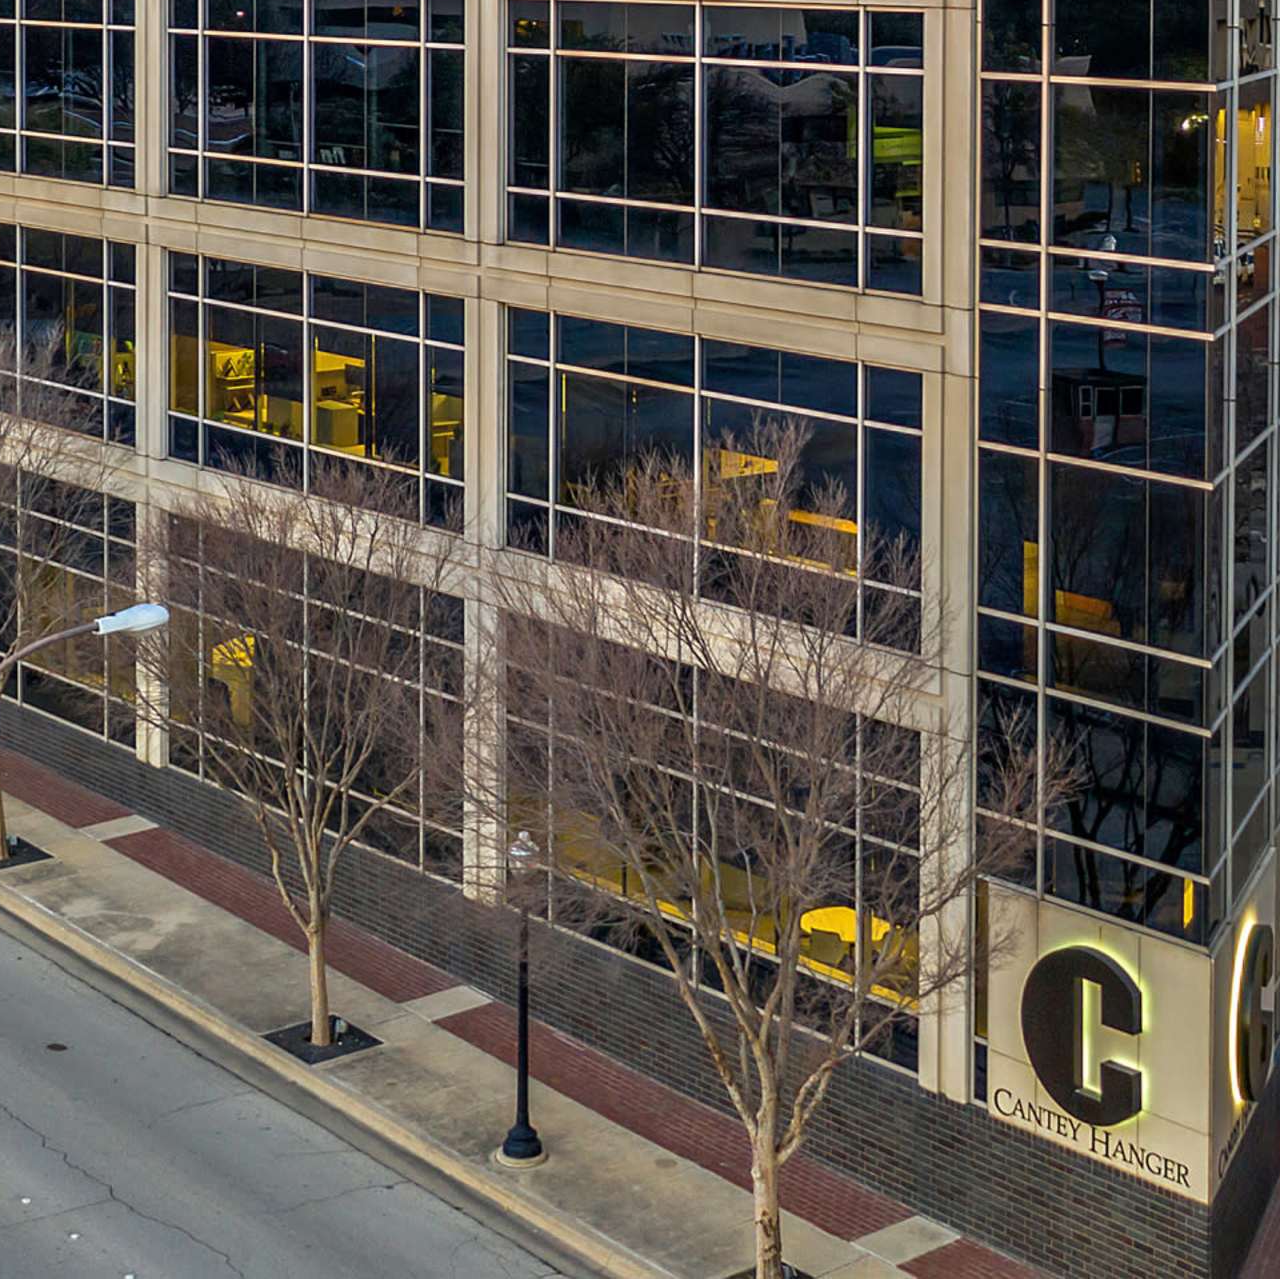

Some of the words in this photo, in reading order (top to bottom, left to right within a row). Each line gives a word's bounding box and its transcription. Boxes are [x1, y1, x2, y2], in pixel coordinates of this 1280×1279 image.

[1020, 945, 1143, 1127] C
[993, 1087, 1082, 1143] CANTEY
[1088, 1125, 1192, 1189] HANGER
